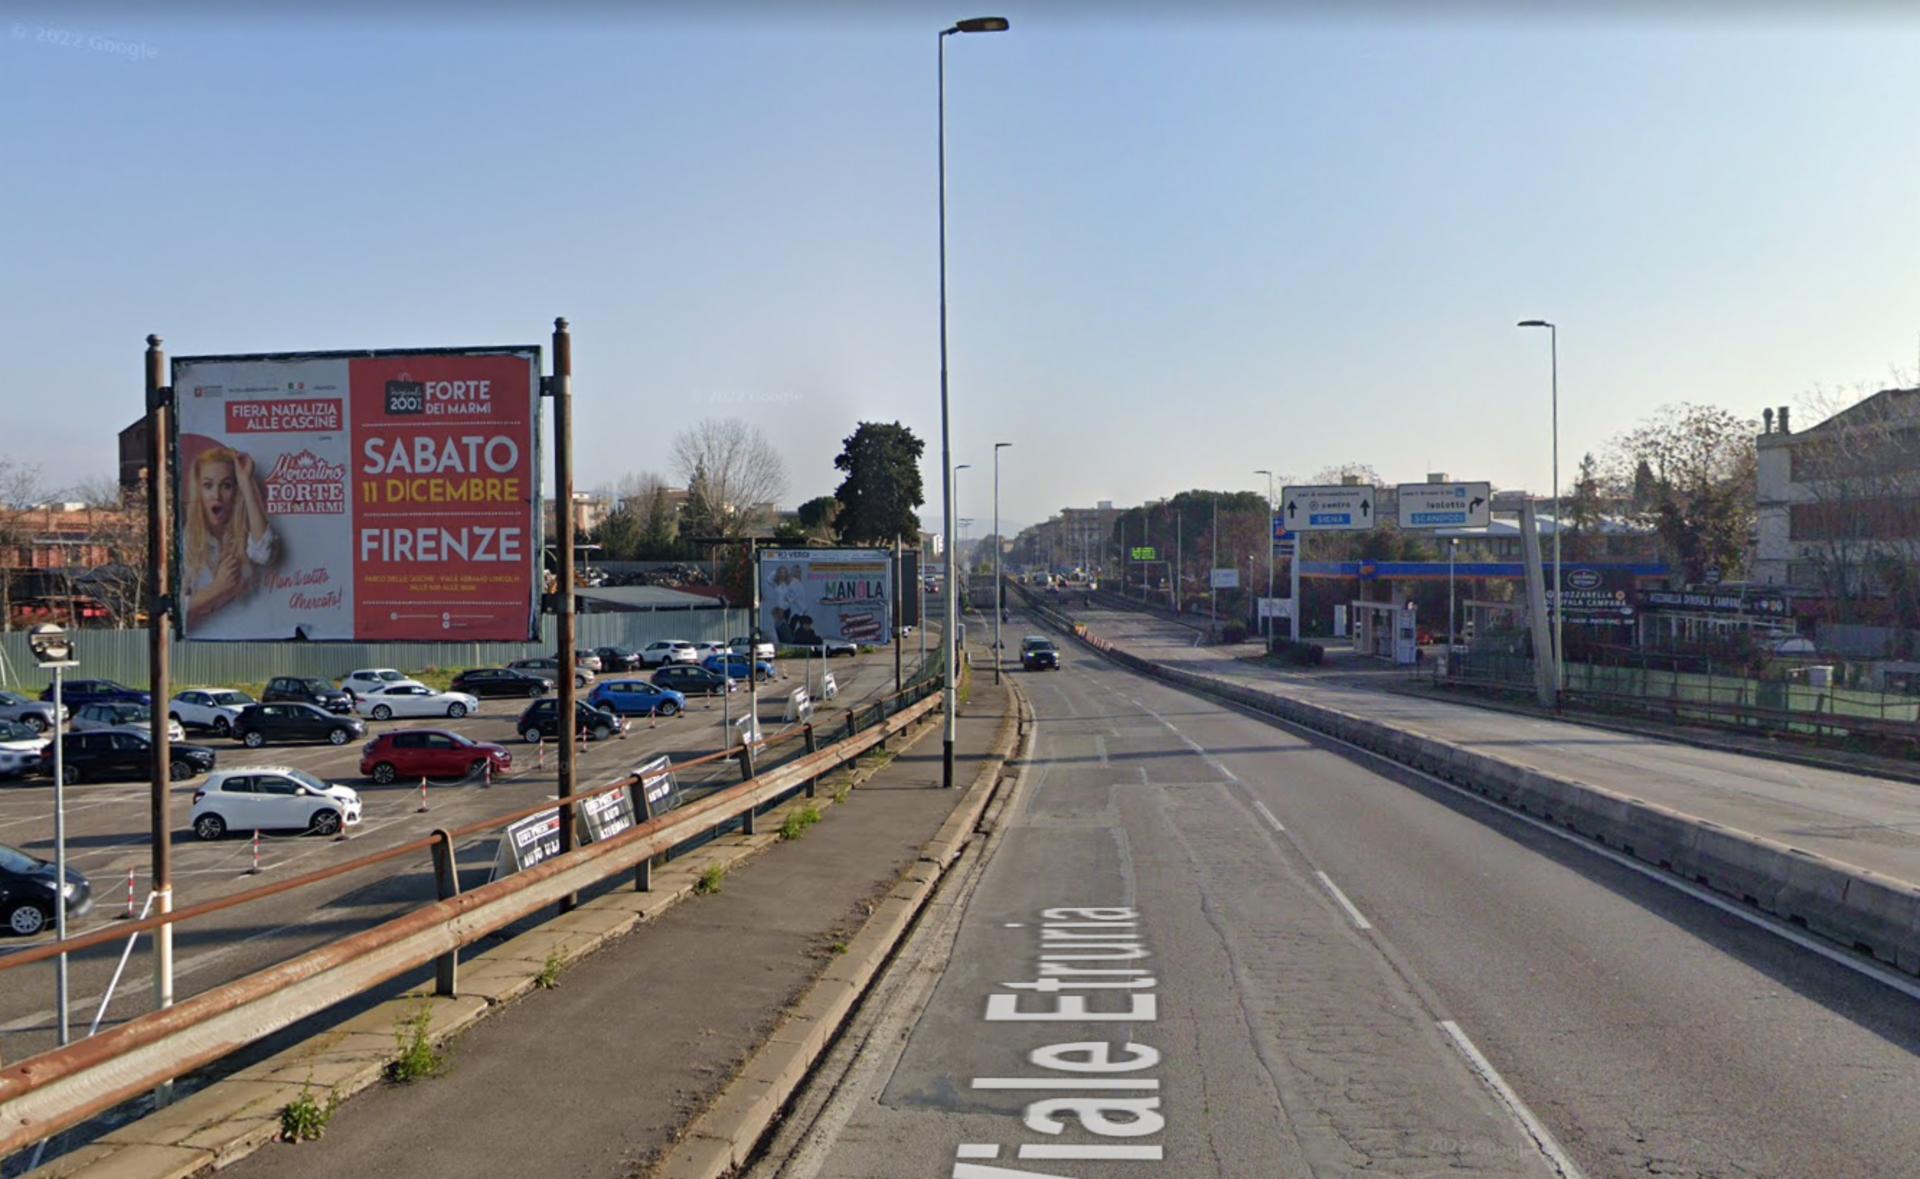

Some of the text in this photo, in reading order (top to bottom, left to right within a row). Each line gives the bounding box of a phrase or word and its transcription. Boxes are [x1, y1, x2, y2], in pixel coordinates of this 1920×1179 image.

[425, 381, 491, 400] FORTE
[231, 403, 337, 417] FIERA NATALIZIA
[425, 402, 492, 415] DEI MARMI
[246, 415, 337, 430] ALLE CASCINE
[363, 435, 519, 474] SABATO
[265, 453, 343, 482] Mercatino
[267, 484, 344, 501] FORTE
[363, 478, 520, 503] 11 DICEMBRE
[267, 502, 344, 513] DEI MARMI
[361, 527, 522, 562] FIRENZE
[825, 580, 885, 599] MANOLA
